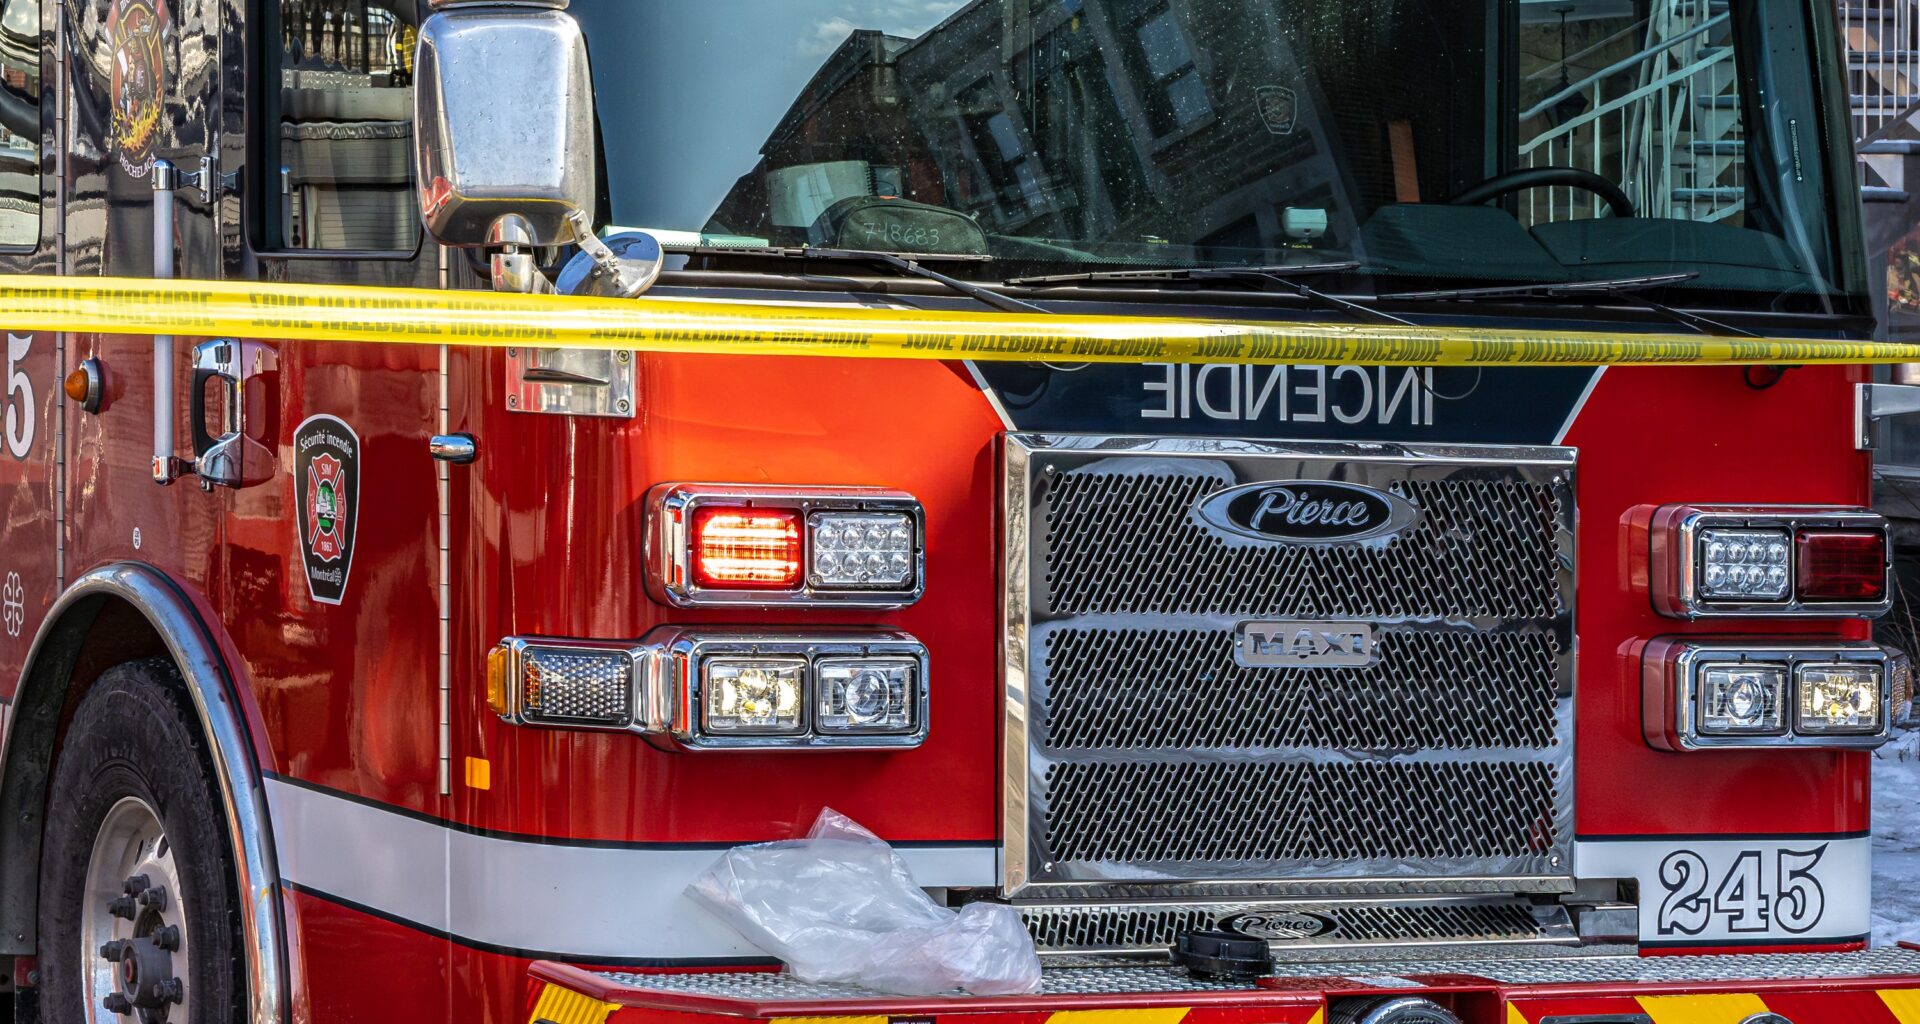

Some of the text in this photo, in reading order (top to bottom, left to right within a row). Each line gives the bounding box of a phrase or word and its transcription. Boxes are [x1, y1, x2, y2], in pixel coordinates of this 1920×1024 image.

[120, 151, 156, 178] HOCHELAGA
[1, 331, 37, 461] 5
[300, 428, 353, 459] Sécurité incendie
[320, 463, 332, 476] SIM
[1249, 486, 1371, 531] Pierce
[320, 540, 333, 553] 1863
[310, 565, 335, 584] Montréal
[1249, 628, 1367, 657] MAXI
[1657, 841, 1830, 936] 245
[1240, 915, 1316, 933] Pierce
